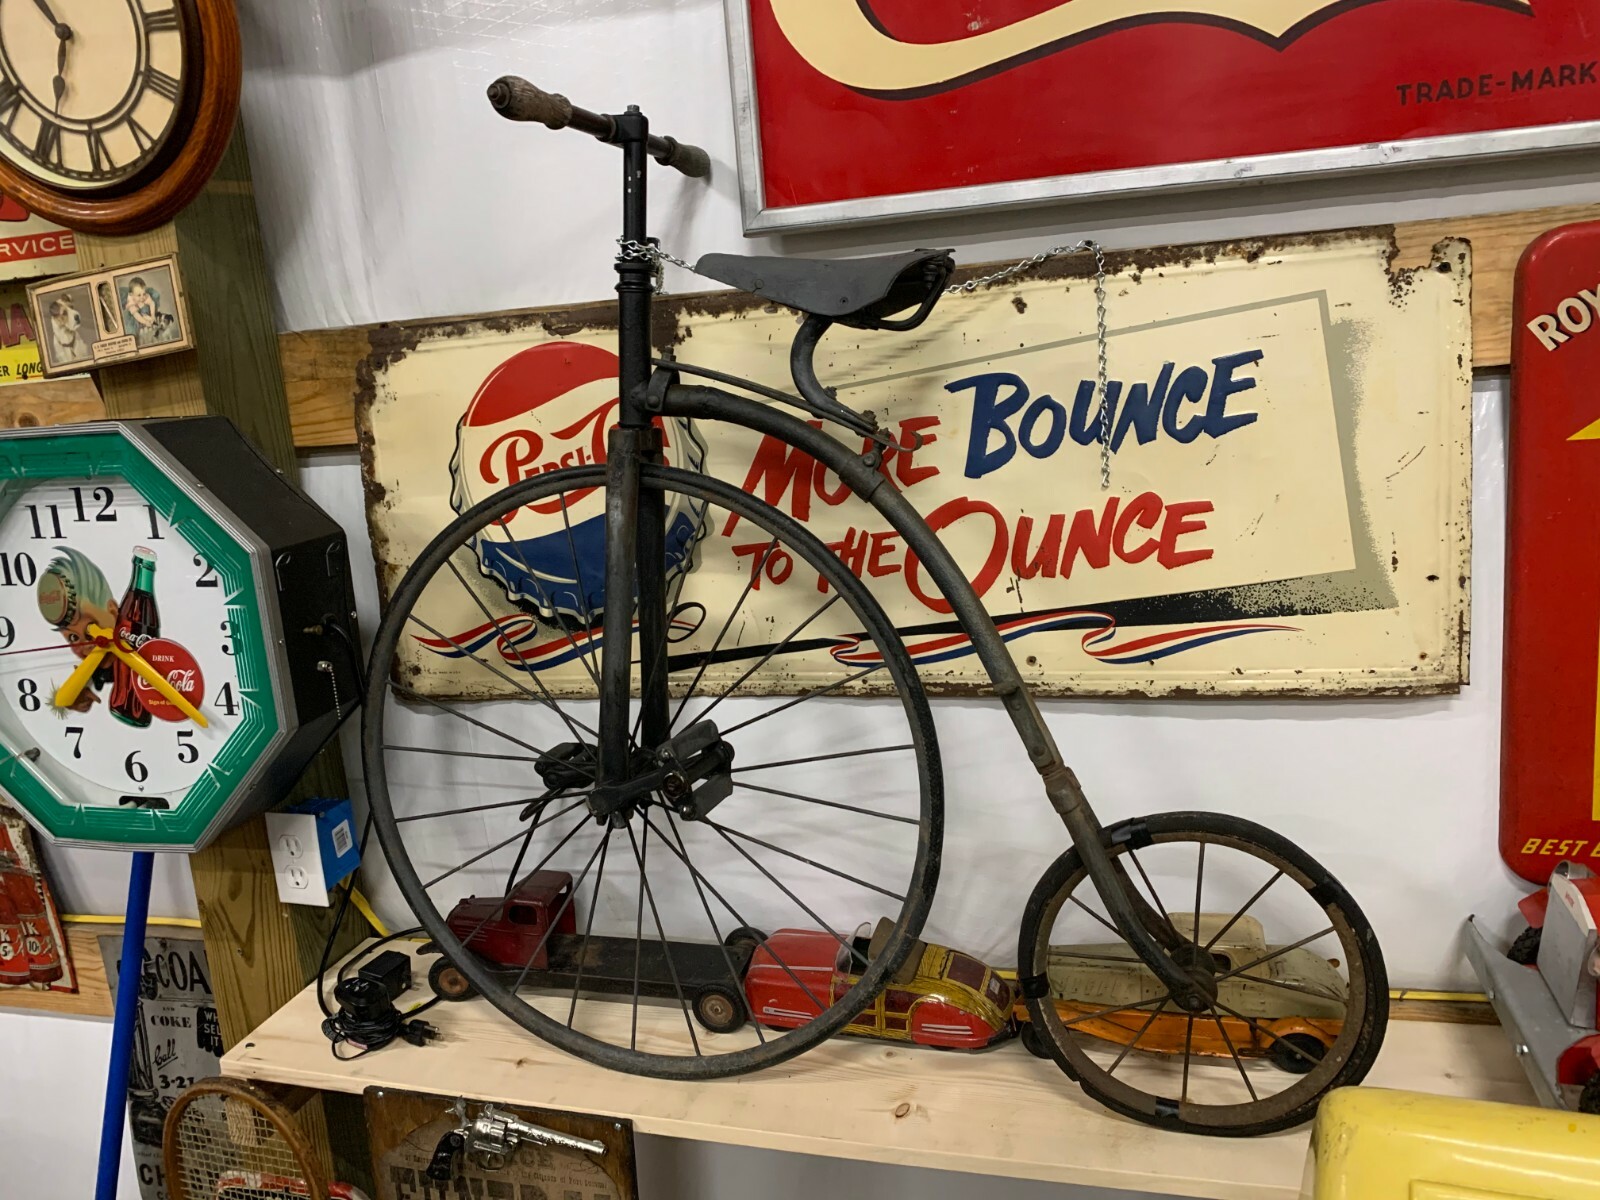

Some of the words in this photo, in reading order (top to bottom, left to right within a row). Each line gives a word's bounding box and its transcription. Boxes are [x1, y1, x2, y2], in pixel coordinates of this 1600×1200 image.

[1396, 61, 1599, 106] TRADE-MARK
[721, 416, 941, 537] MORE
[944, 348, 1264, 479] BOUNCE
[68, 486, 117, 521] 12
[24, 504, 68, 539] 11
[142, 504, 165, 540] 1
[0, 552, 37, 587] 10
[192, 552, 219, 588] 2
[731, 541, 794, 591] TO
[904, 491, 1214, 614] OUNCE
[219, 619, 240, 656] 3
[152, 654, 175, 663] DRINK
[18, 678, 41, 712] 8
[214, 682, 240, 716] 4
[64, 726, 84, 759] 7
[176, 729, 199, 764] 5
[124, 750, 149, 783] 6
[1521, 838, 1589, 857] BEST
[155, 950, 213, 994] COA
[150, 1014, 192, 1028] COKE
[203, 1023, 222, 1036] SEL
